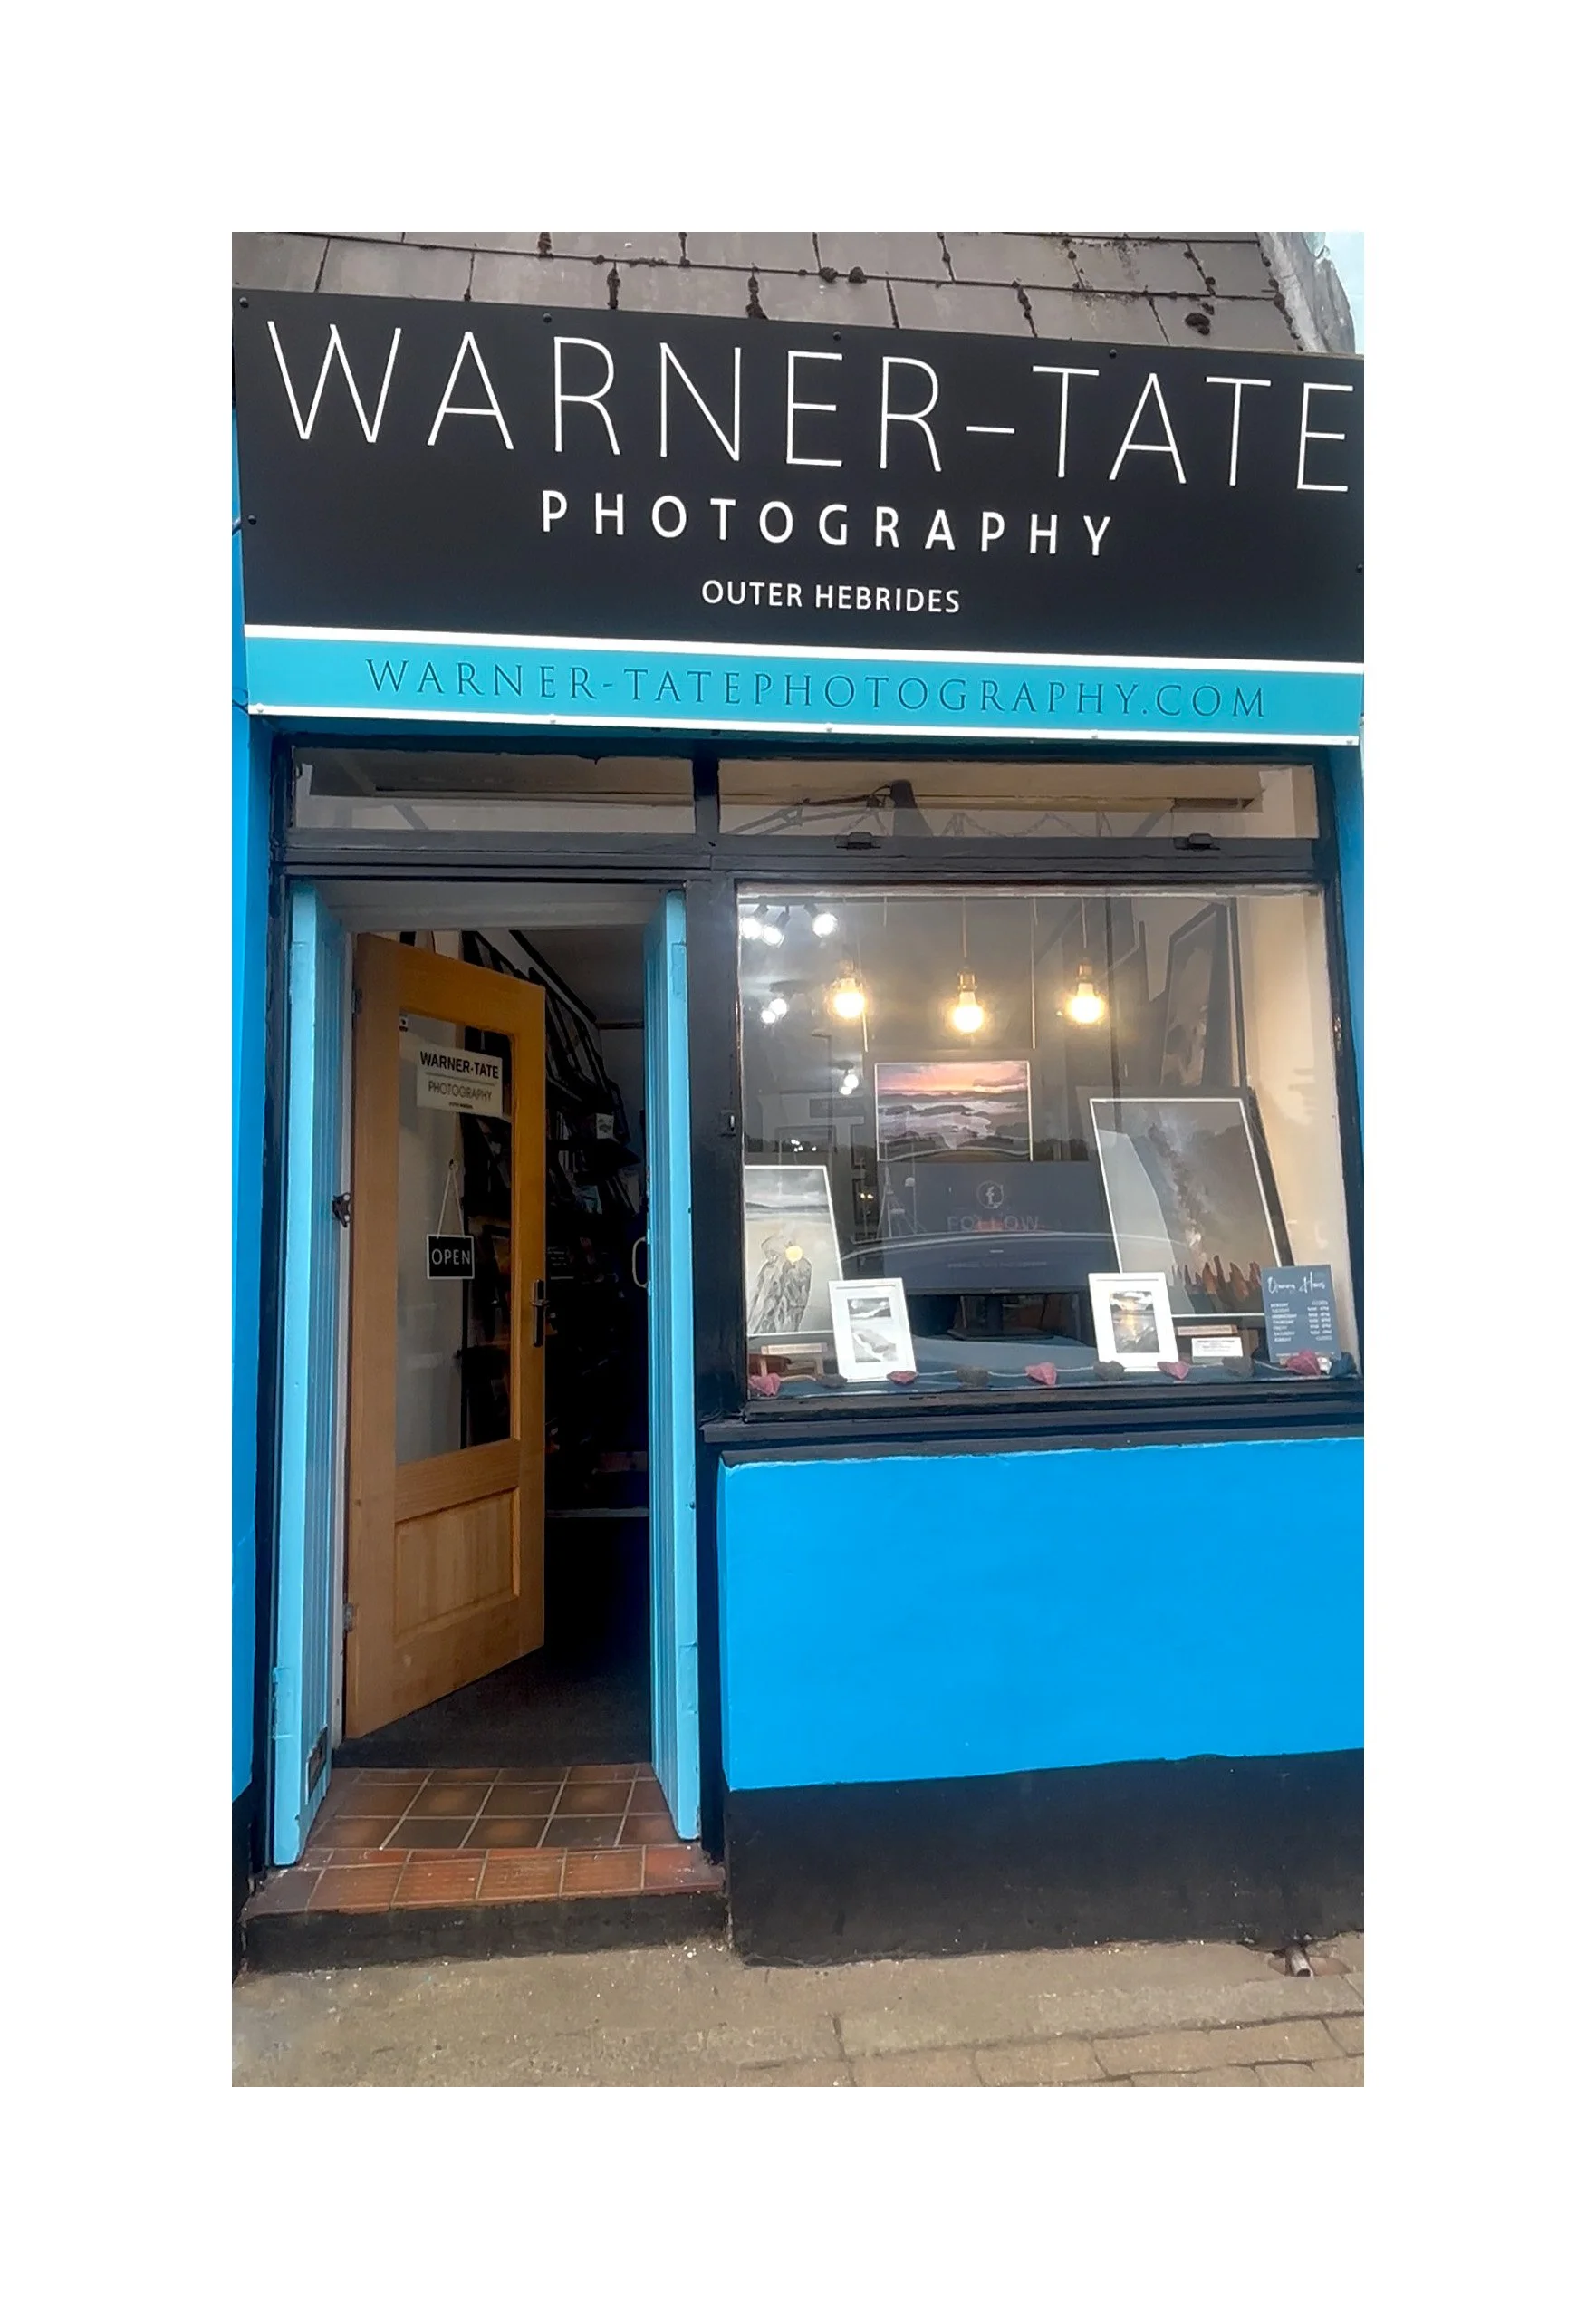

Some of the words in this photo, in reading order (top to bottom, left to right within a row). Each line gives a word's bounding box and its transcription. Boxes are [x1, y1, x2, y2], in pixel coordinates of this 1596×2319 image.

[267, 321, 1354, 493] WARNER-TATE
[543, 489, 1111, 556] PHOTOGRAPHY
[702, 579, 803, 608] OUTER
[815, 584, 960, 613] HEBRIDES
[365, 658, 1264, 718] WARNER-TATEPHOTOGRAPHY.COM
[428, 1080, 493, 1102] PHOTOGRAPHY
[430, 1247, 471, 1265] OPEN
